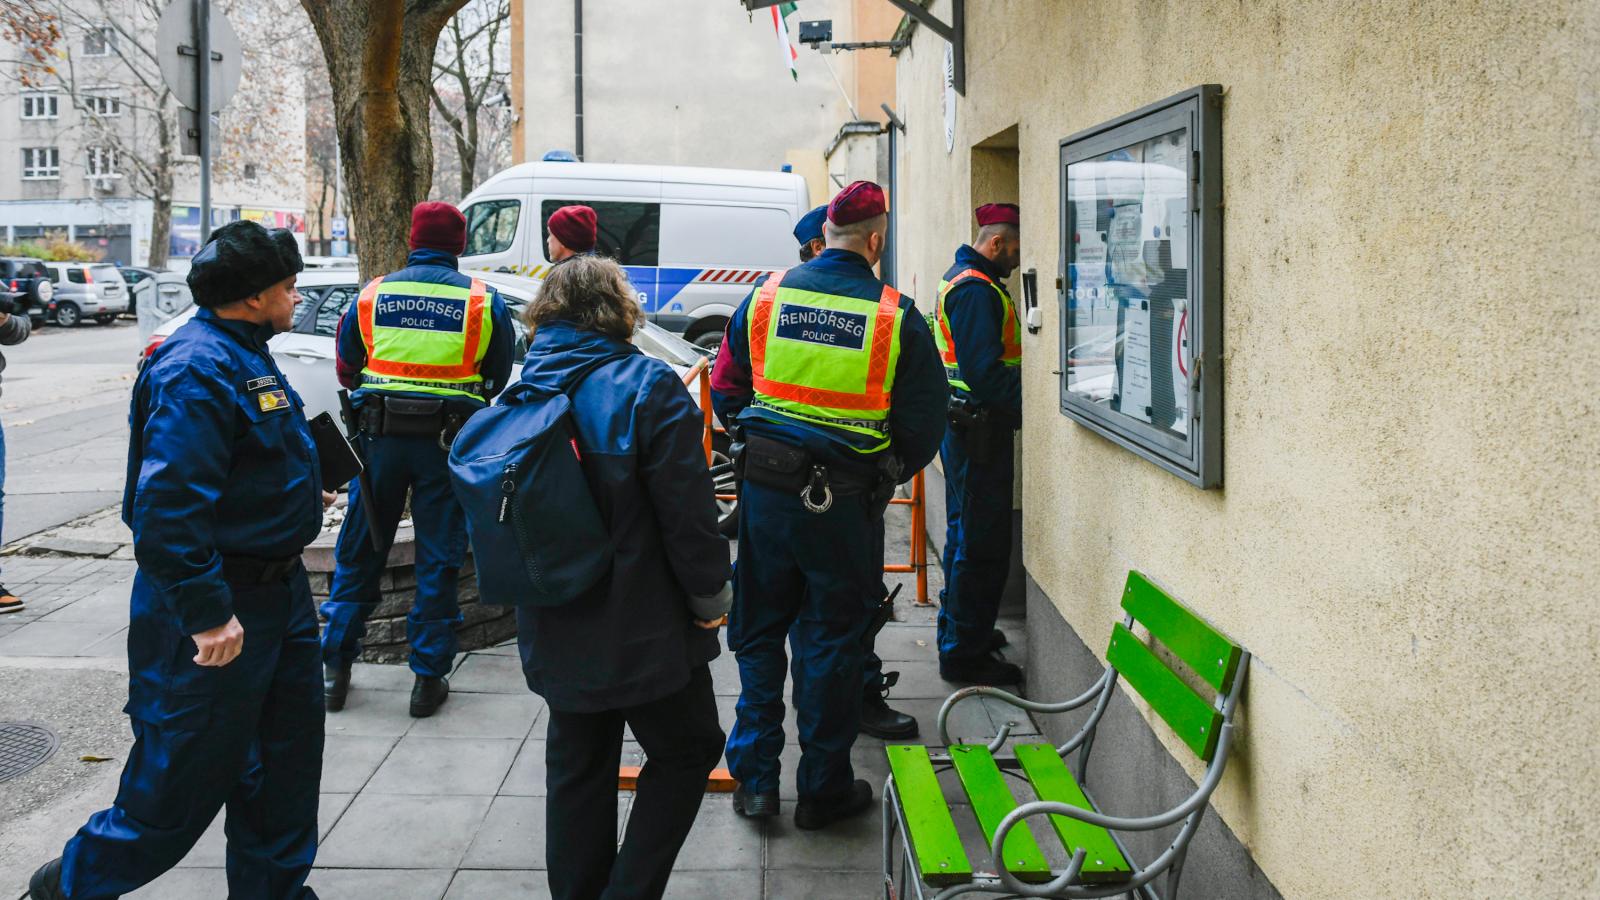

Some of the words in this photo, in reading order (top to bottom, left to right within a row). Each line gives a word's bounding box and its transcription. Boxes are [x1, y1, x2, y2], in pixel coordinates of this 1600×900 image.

[377, 297, 463, 320] RENDŐRSÉG
[400, 317, 434, 328] POLICE
[780, 309, 864, 338] RENDŐRSÉG
[801, 330, 836, 343] POLICE
